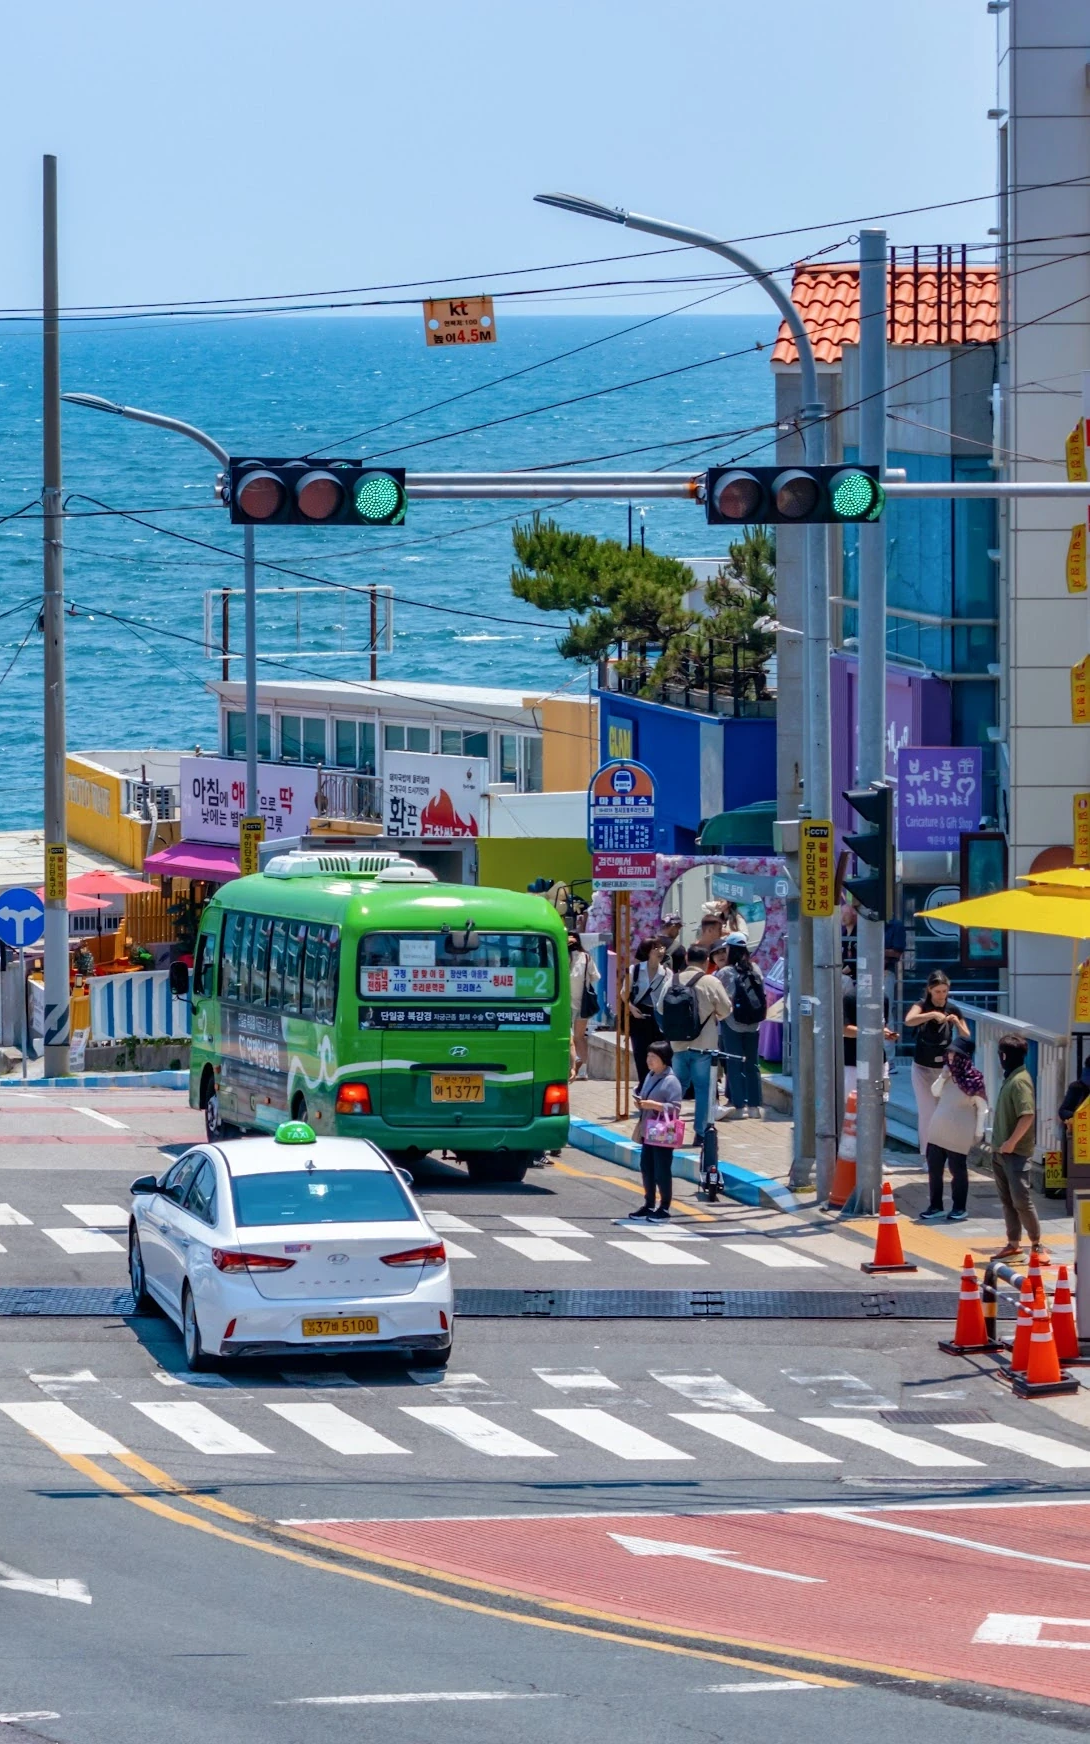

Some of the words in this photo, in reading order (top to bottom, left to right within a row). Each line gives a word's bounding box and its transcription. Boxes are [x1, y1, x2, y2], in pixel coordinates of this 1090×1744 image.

[449, 300, 469, 316] kt
[192, 777, 229, 808] 아침에
[279, 787, 294, 815] 딱
[905, 815, 939, 828] Caricature
[810, 828, 828, 836] CCTV
[806, 841, 816, 911] 무인단속구간
[819, 841, 828, 911] 불법주정차
[534, 970, 548, 993] 2
[446, 1086, 481, 1099] 1377
[342, 1319, 373, 1332] 5100
